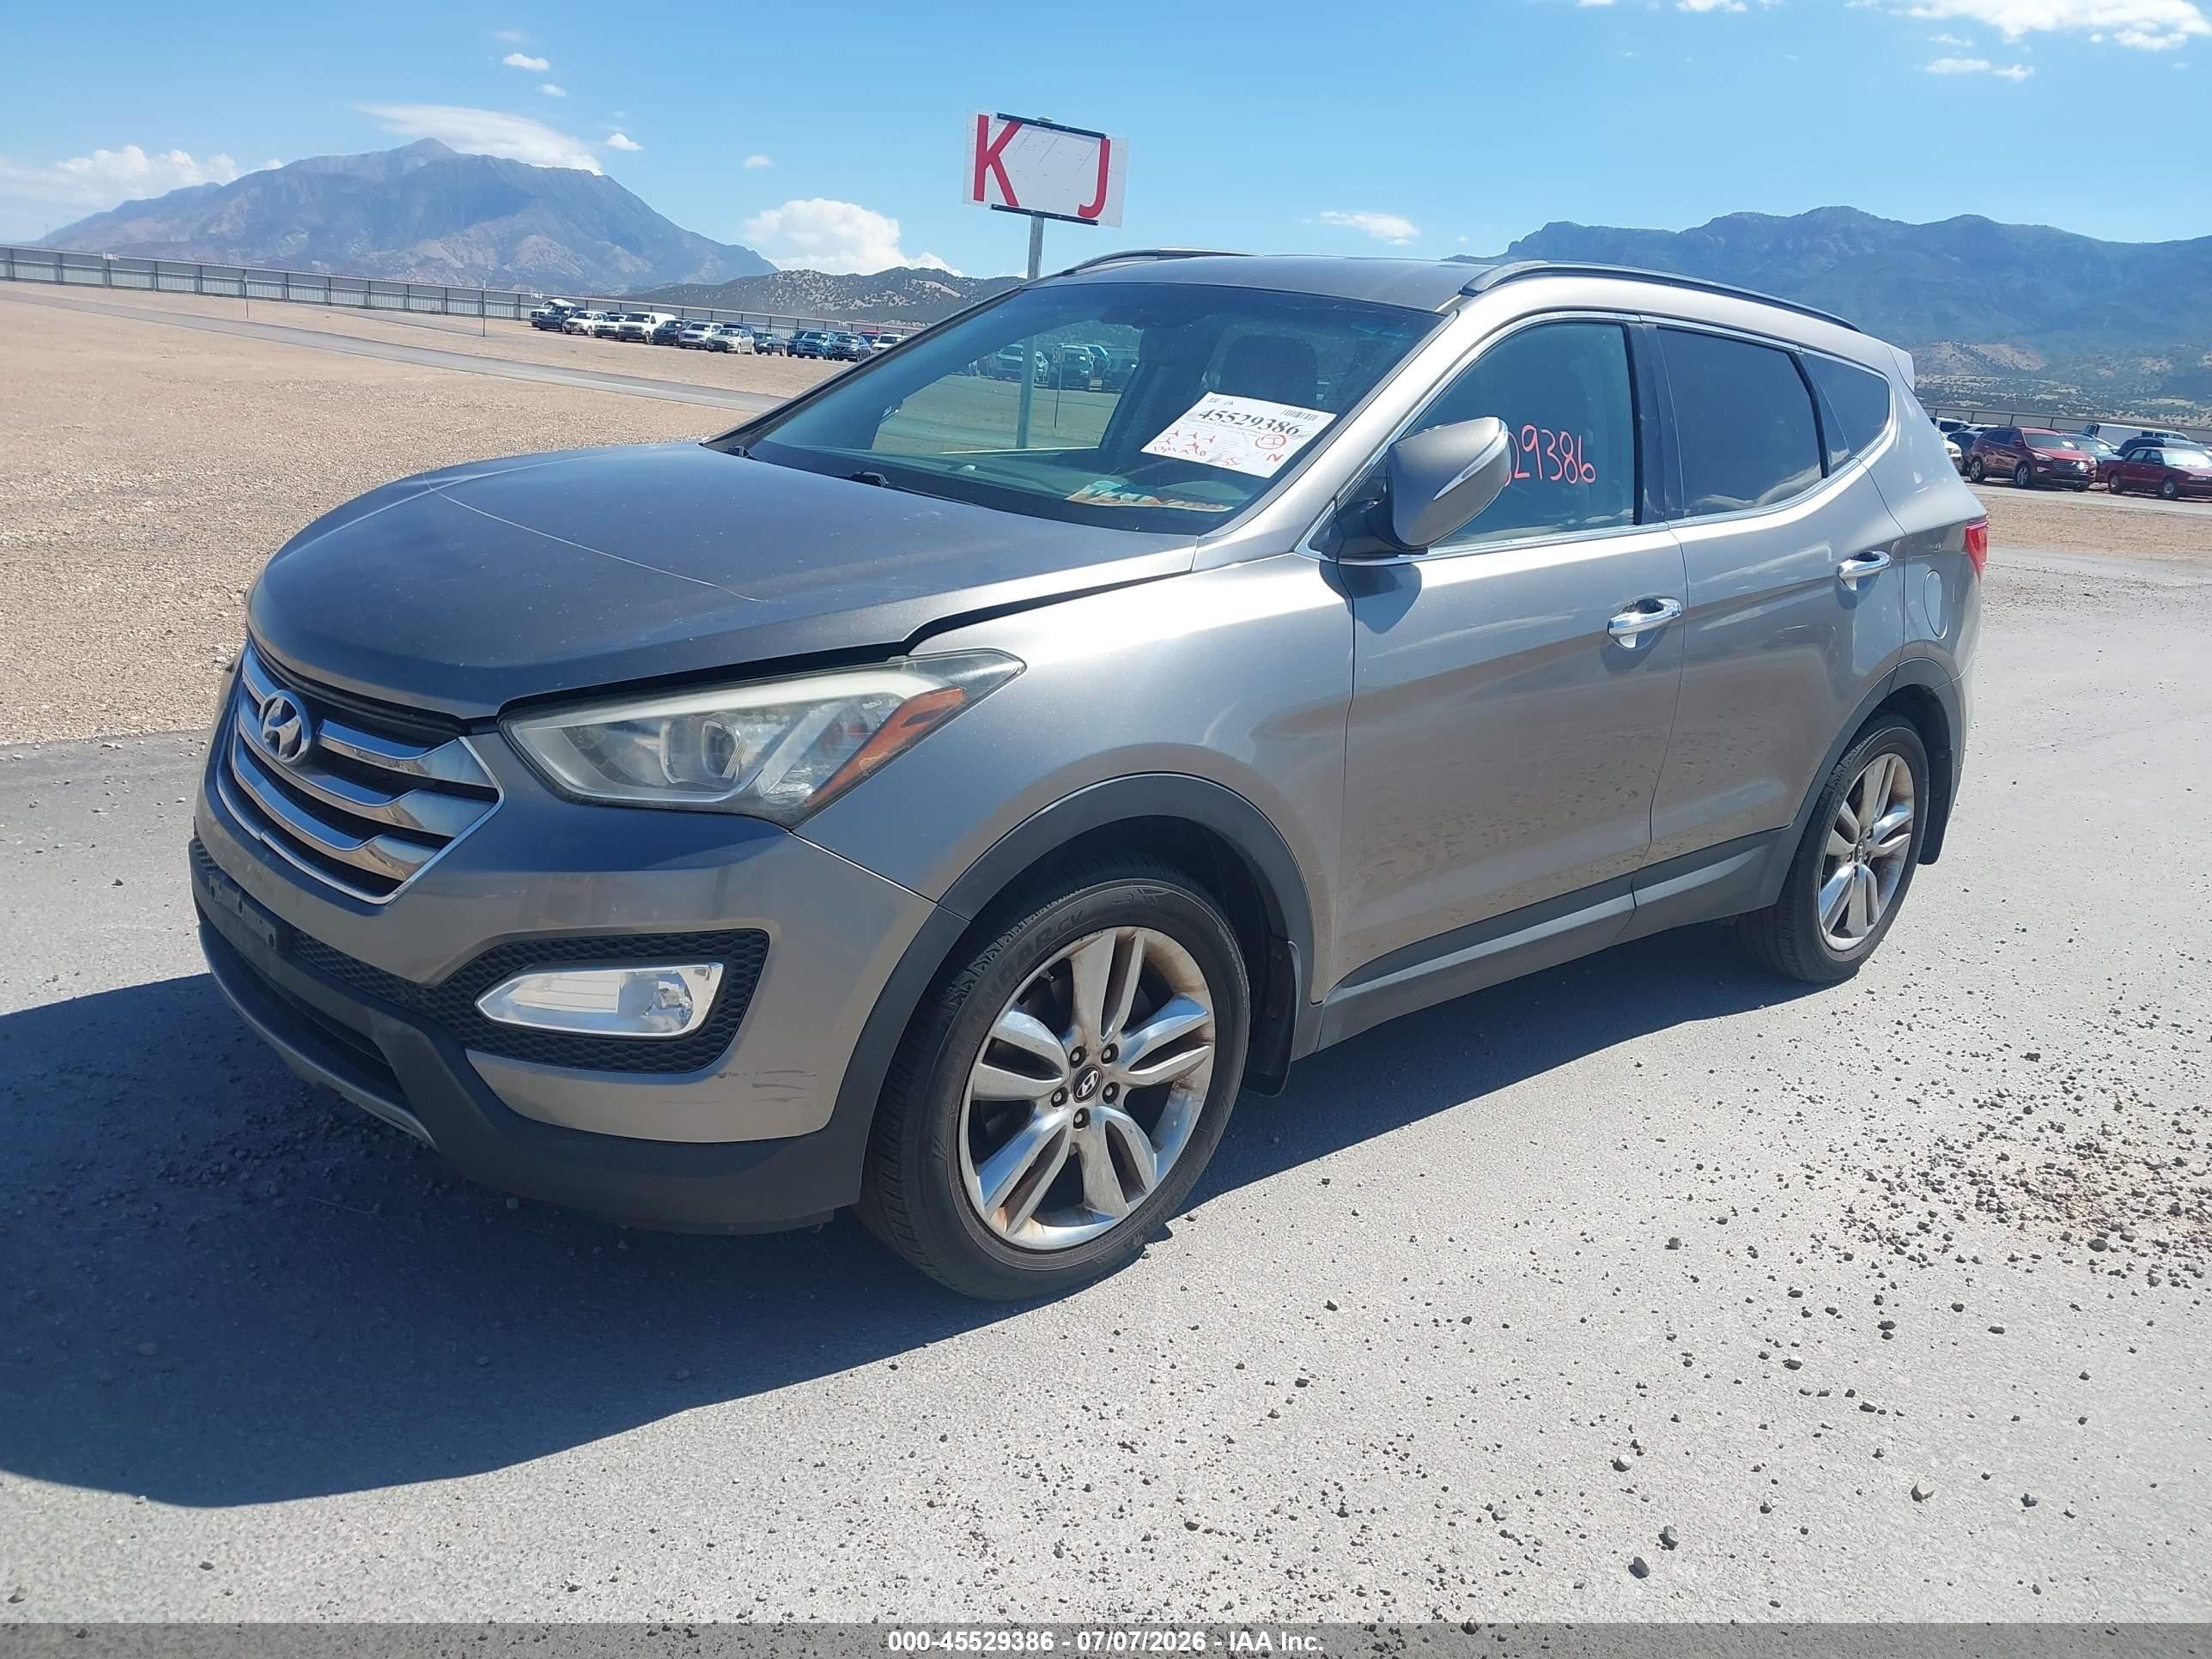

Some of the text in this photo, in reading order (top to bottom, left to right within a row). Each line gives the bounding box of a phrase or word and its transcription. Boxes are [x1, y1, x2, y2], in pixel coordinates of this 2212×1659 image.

[973, 113, 1111, 219] K J
[1199, 409, 1305, 435] 45529386
[1504, 424, 1596, 488] 29386
